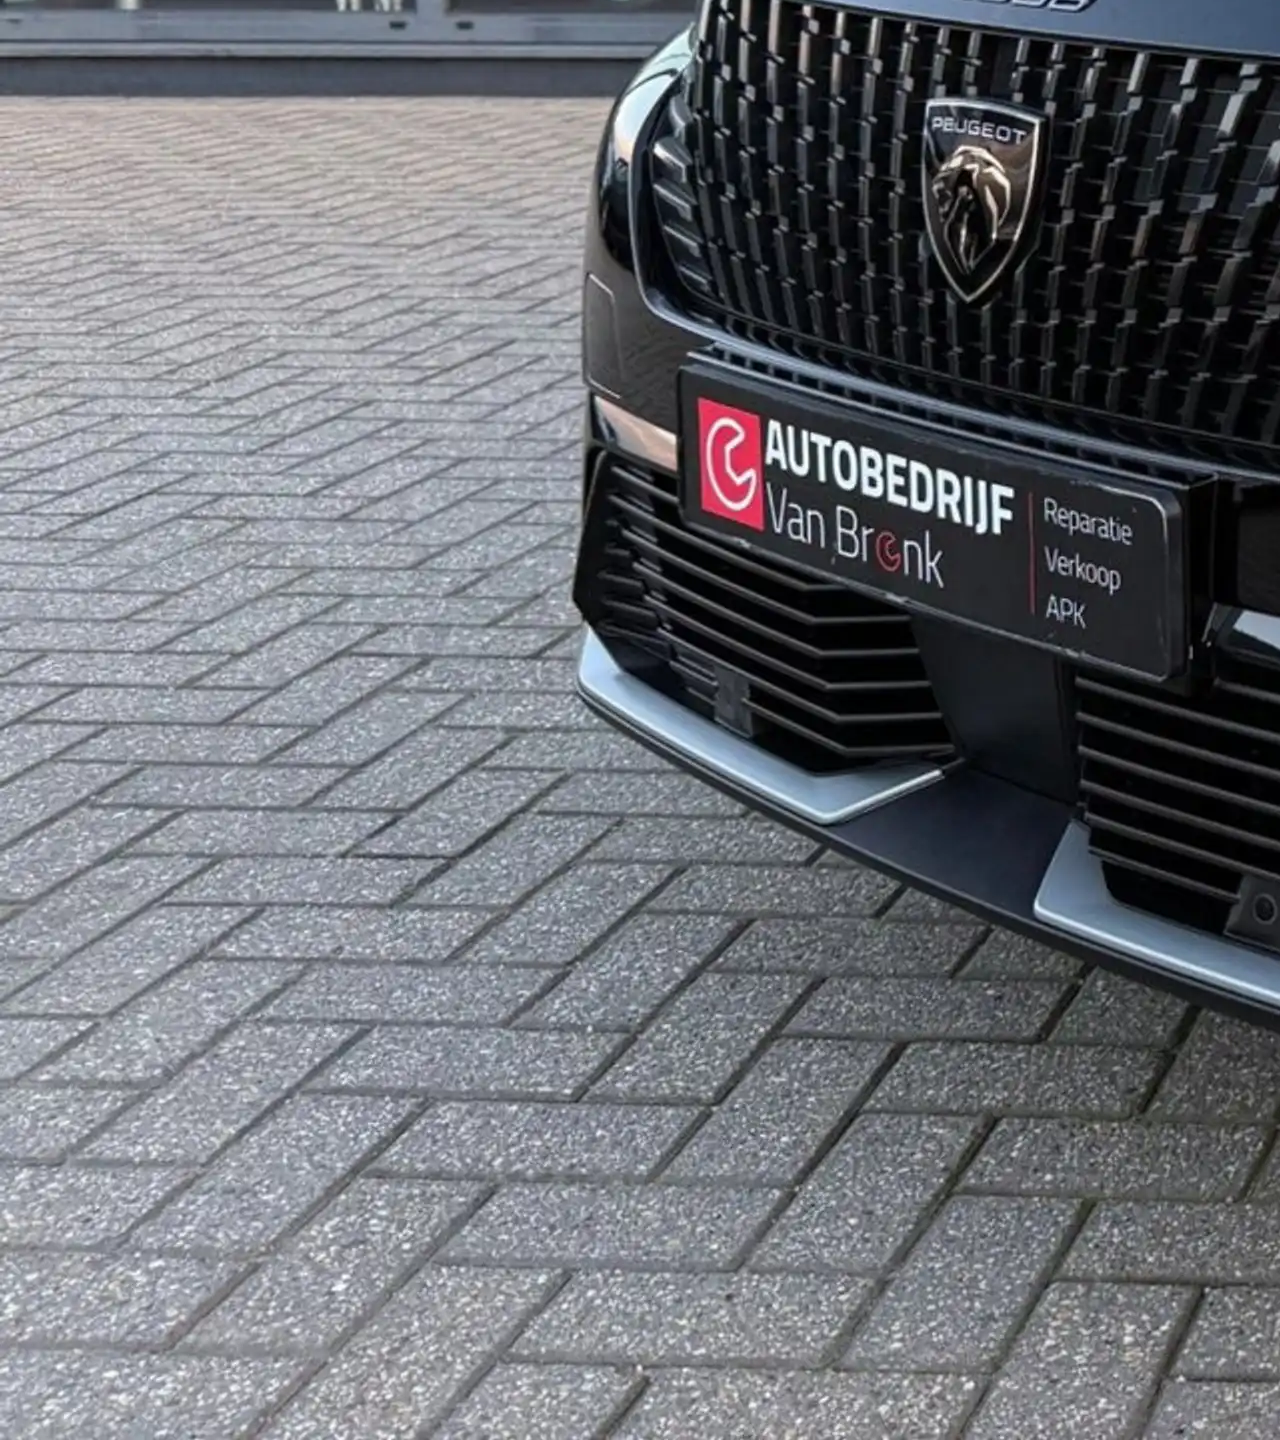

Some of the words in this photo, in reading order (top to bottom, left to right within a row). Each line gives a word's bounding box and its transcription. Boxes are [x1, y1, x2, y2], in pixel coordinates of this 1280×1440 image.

[931, 115, 1027, 145] PEUGEOT
[764, 418, 1015, 536] AUTOBEDRIJF
[766, 482, 826, 549] Van
[1043, 497, 1133, 546] Reparatie
[1043, 546, 1122, 596] Verkoop
[1045, 593, 1087, 630] APK
